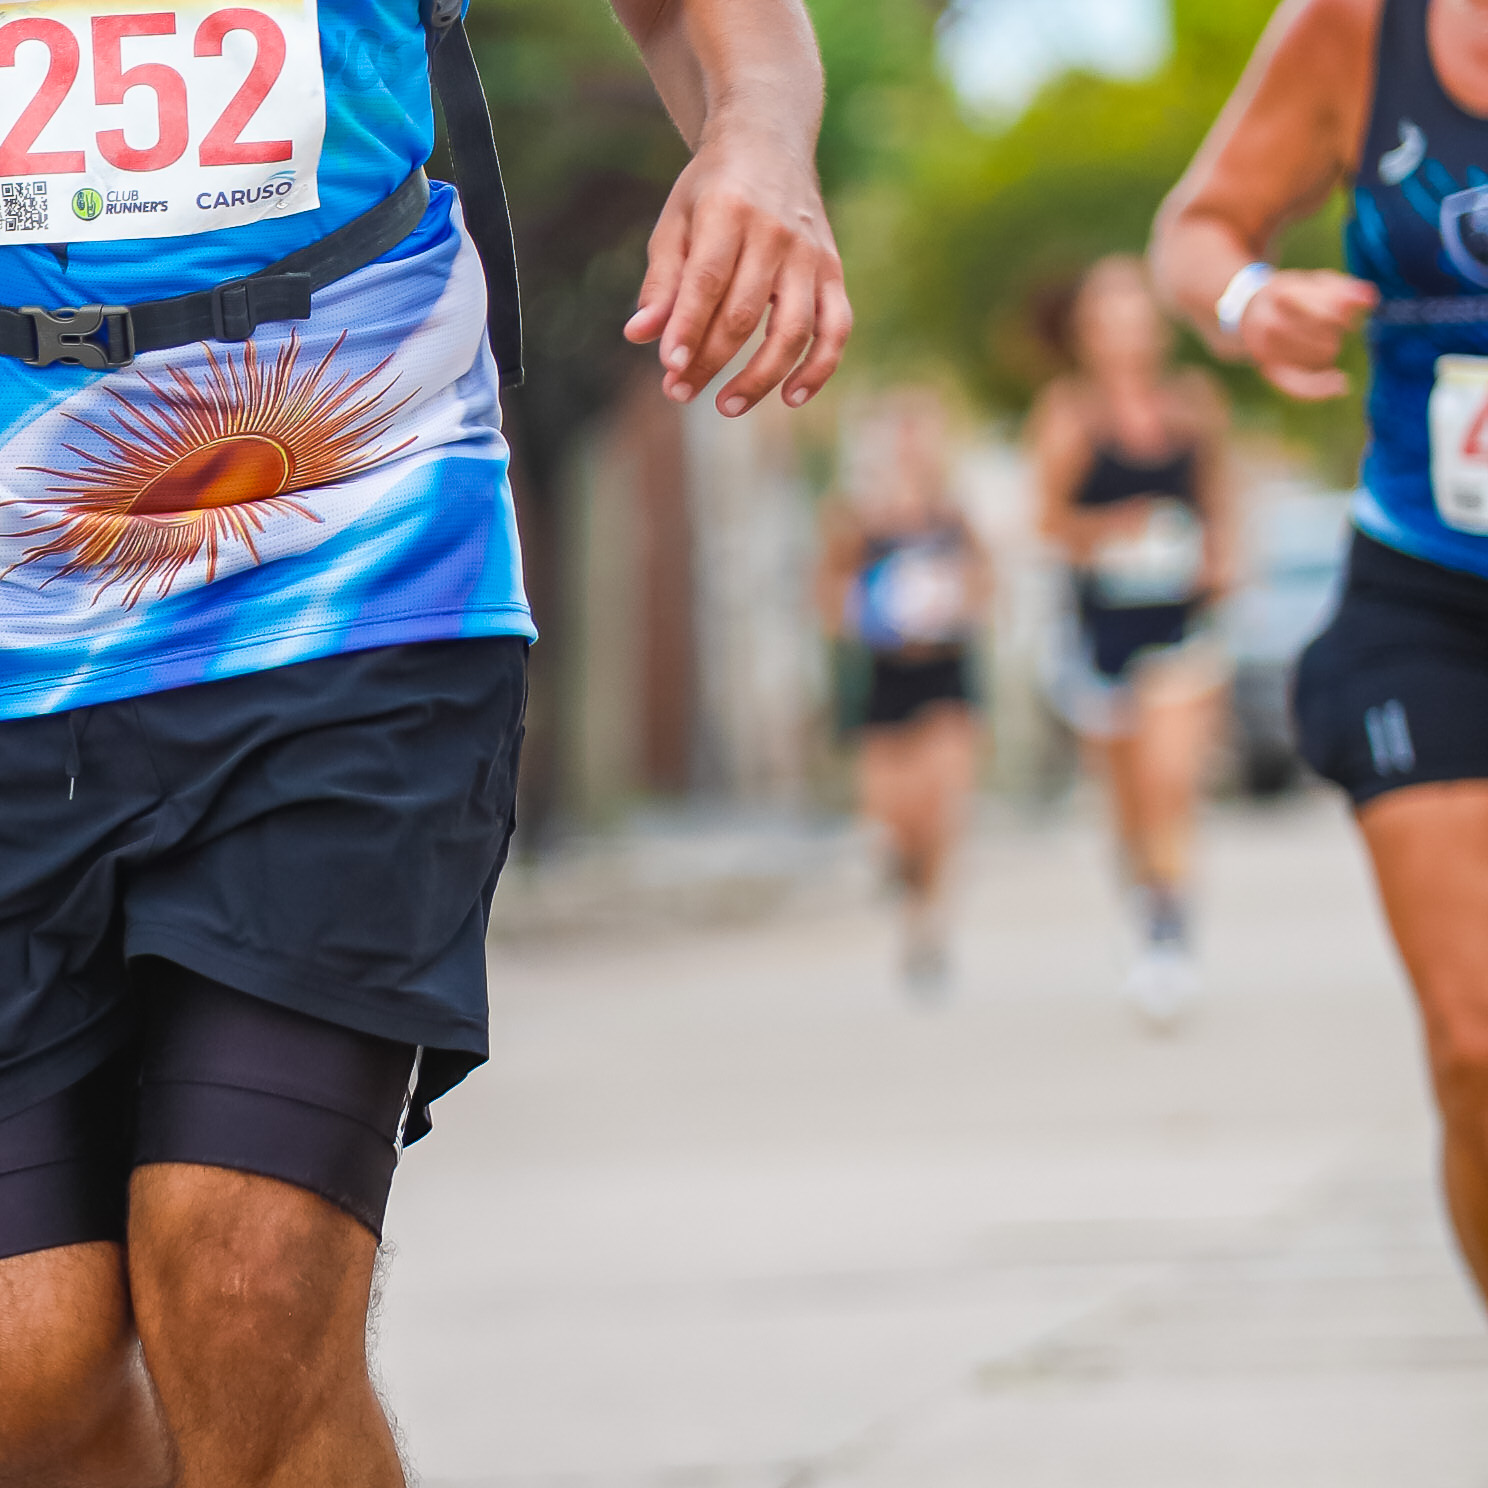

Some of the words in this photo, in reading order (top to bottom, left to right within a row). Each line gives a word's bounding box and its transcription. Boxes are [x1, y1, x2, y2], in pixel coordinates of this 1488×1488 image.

[106, 190, 139, 202] CLUB
[196, 181, 293, 210] CARUSO
[105, 200, 169, 215] RUNNER'S
